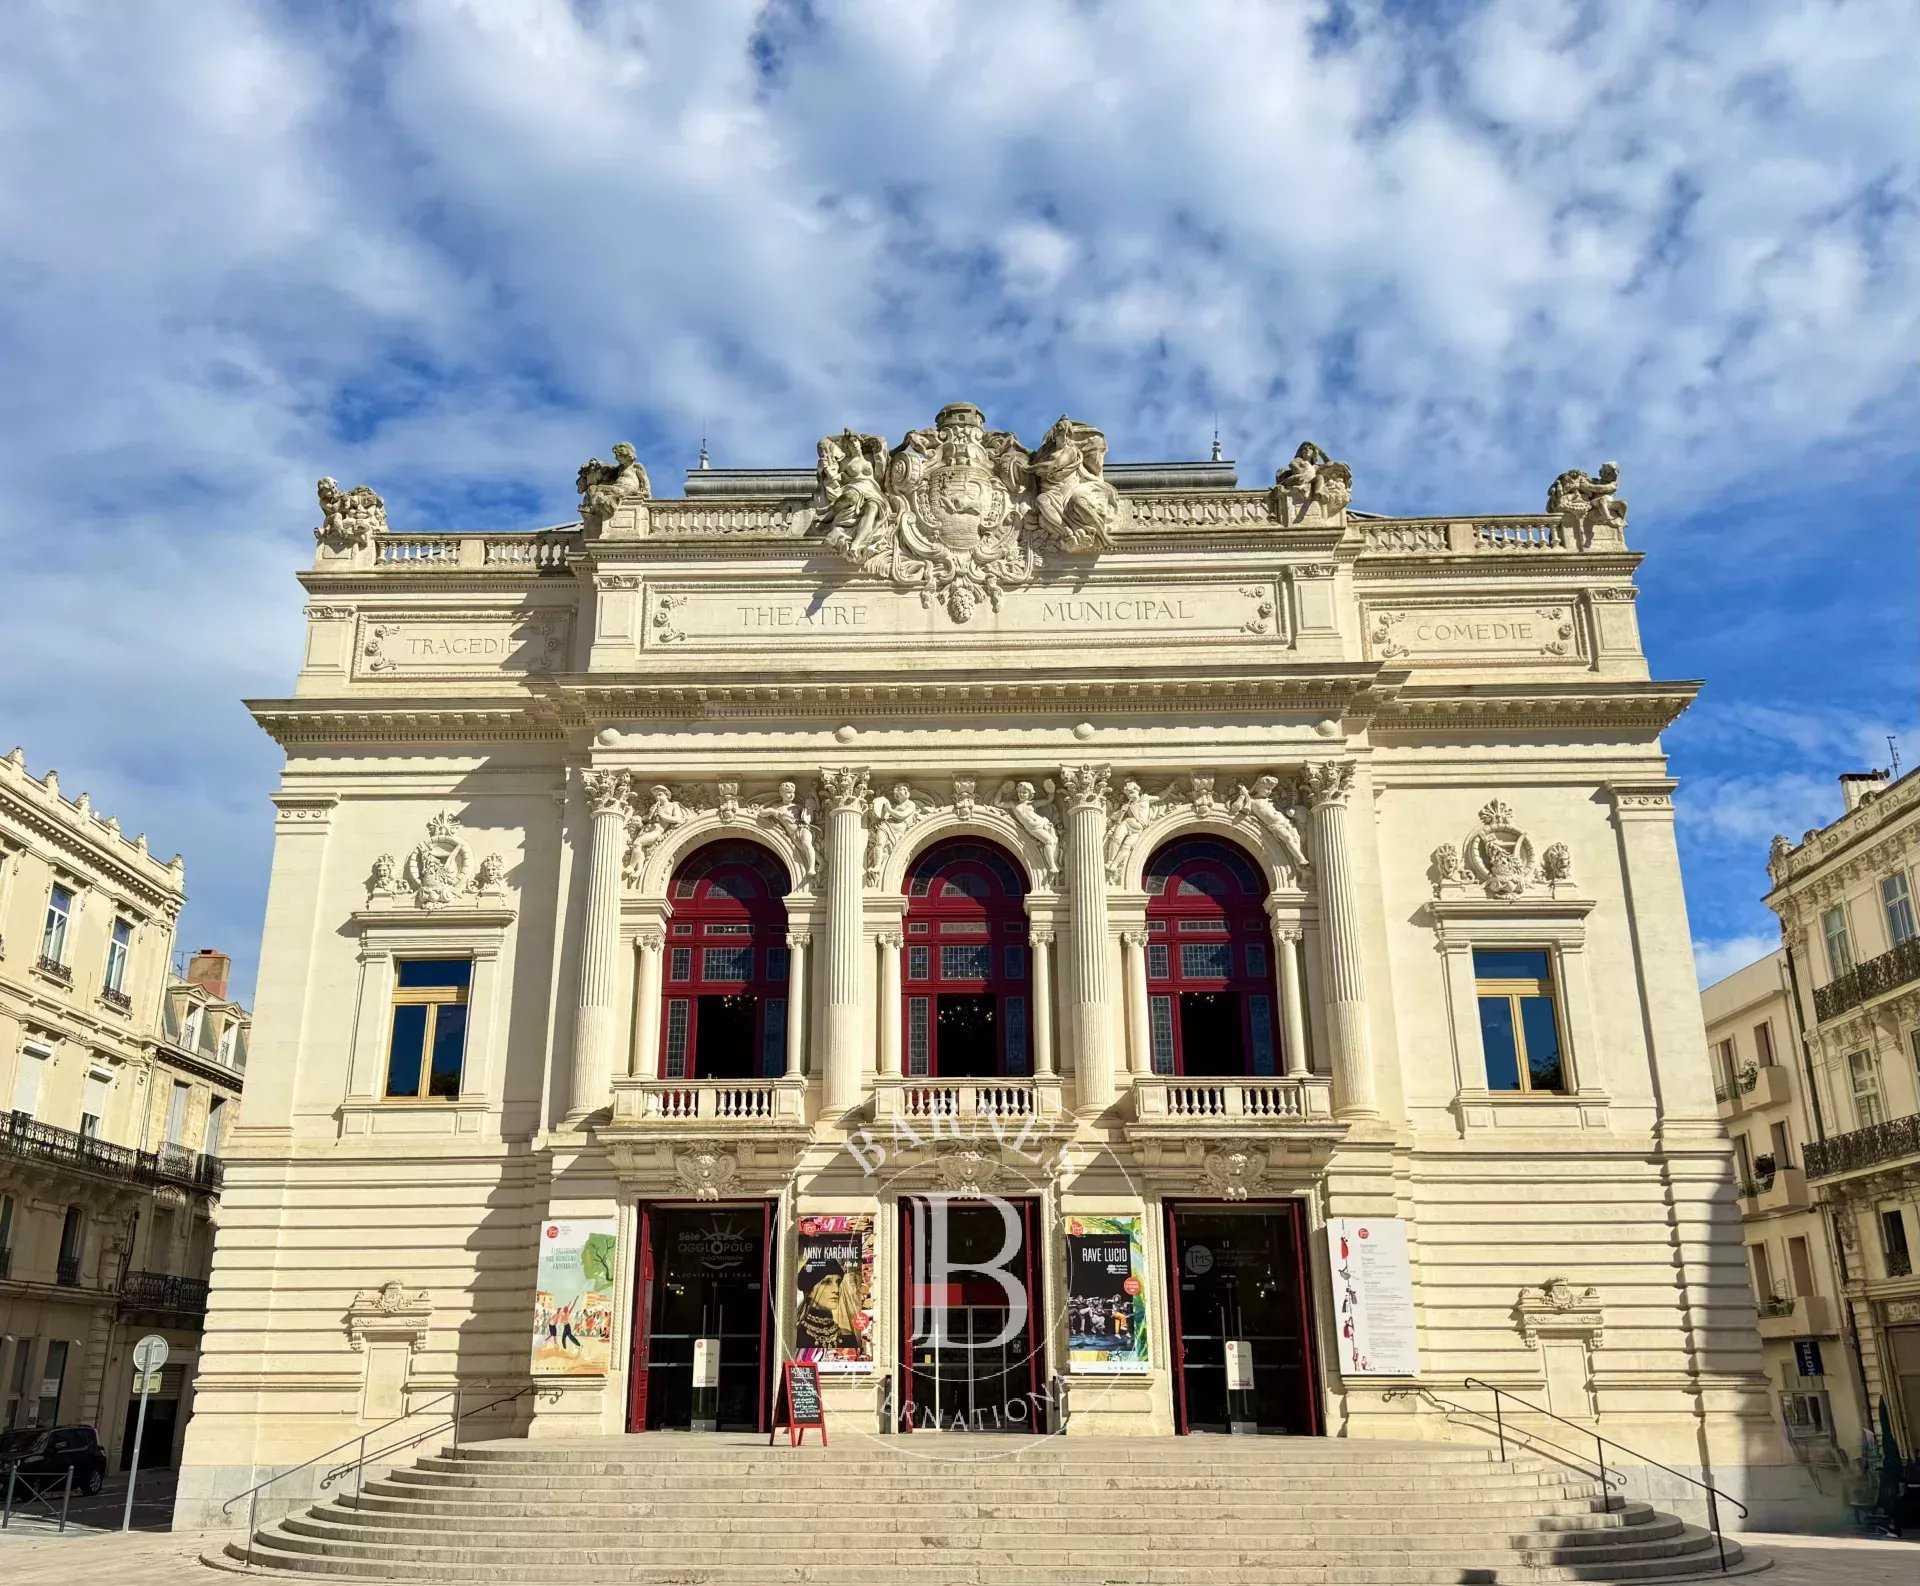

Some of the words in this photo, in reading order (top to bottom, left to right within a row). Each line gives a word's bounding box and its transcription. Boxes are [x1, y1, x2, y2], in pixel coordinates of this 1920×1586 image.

[737, 605, 867, 626] THEATRE
[1042, 600, 1194, 622] MUNICIPAL
[1417, 623, 1533, 641] COMEDIE
[407, 638, 521, 655] TRAGEDIE
[803, 1247, 822, 1260] ANNY
[1082, 1247, 1102, 1262] RAVE
[1104, 1247, 1128, 1262] LUCID
